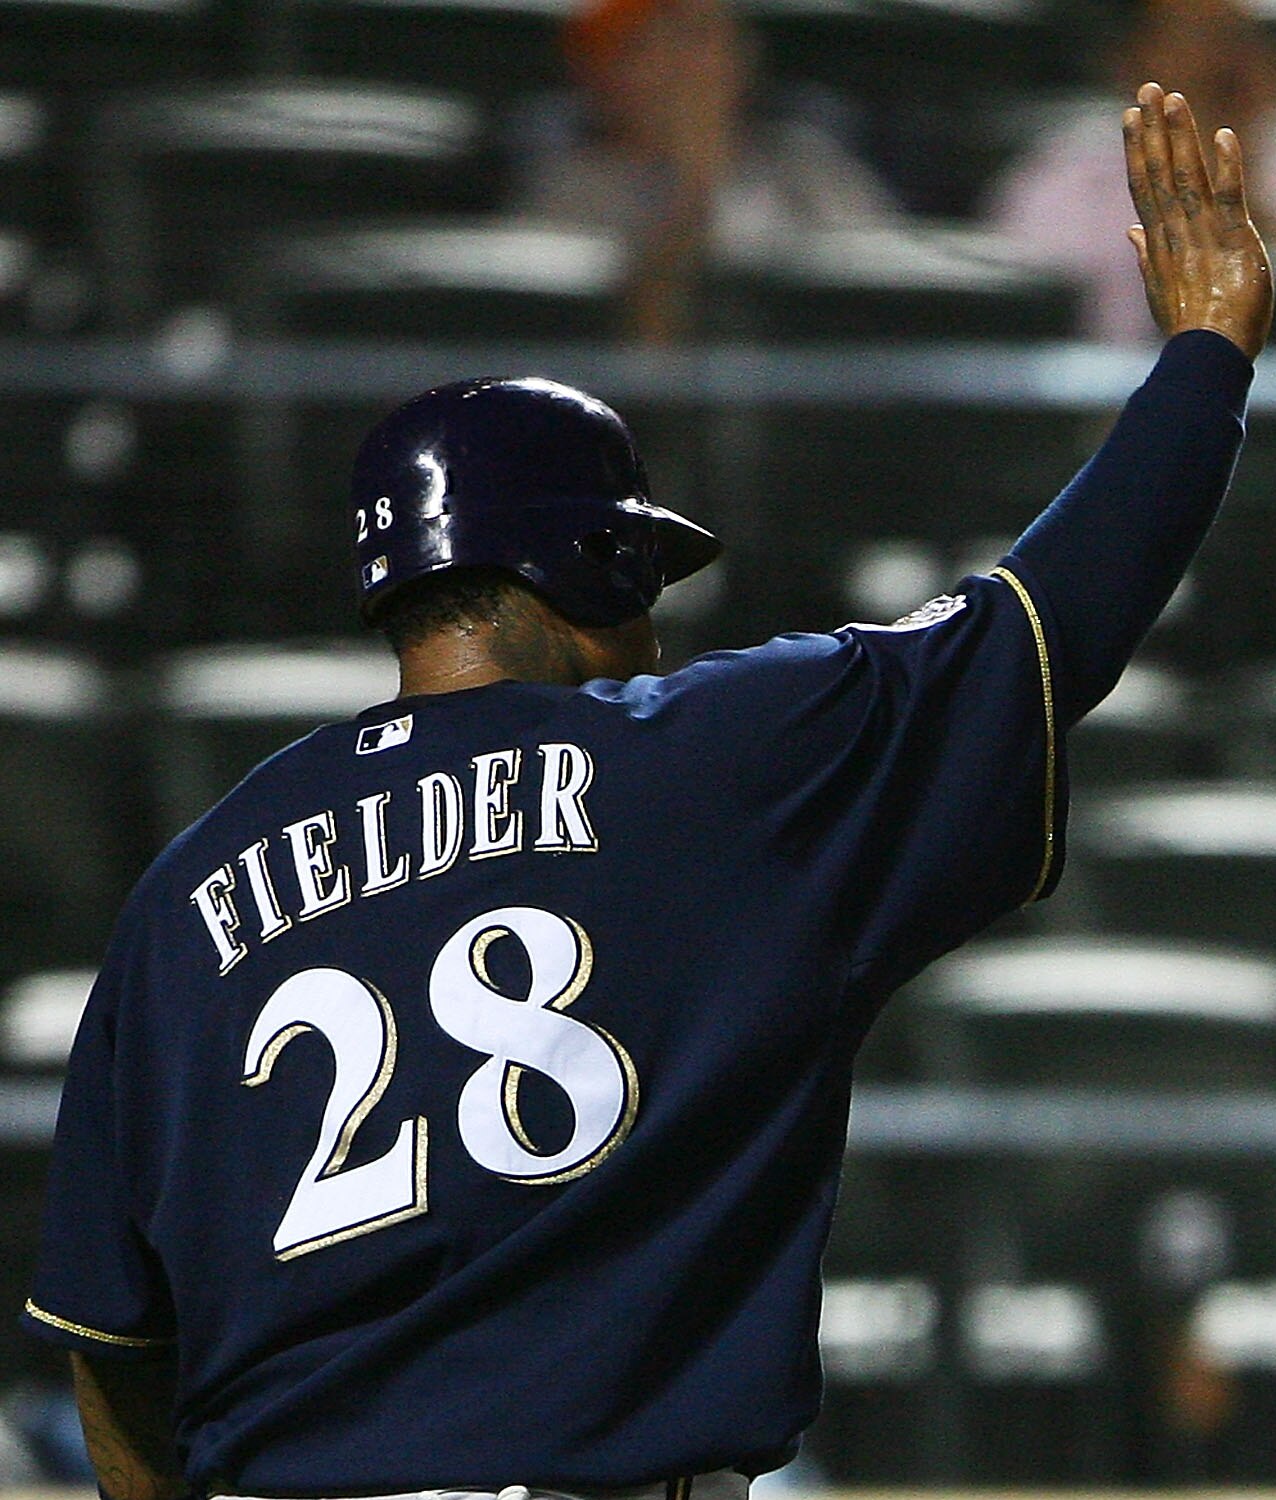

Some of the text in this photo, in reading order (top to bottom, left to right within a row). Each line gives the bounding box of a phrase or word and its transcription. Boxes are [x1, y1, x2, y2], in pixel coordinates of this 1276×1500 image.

[355, 496, 394, 544] 28
[190, 742, 598, 976] FIELDER
[241, 906, 640, 1262] 28
